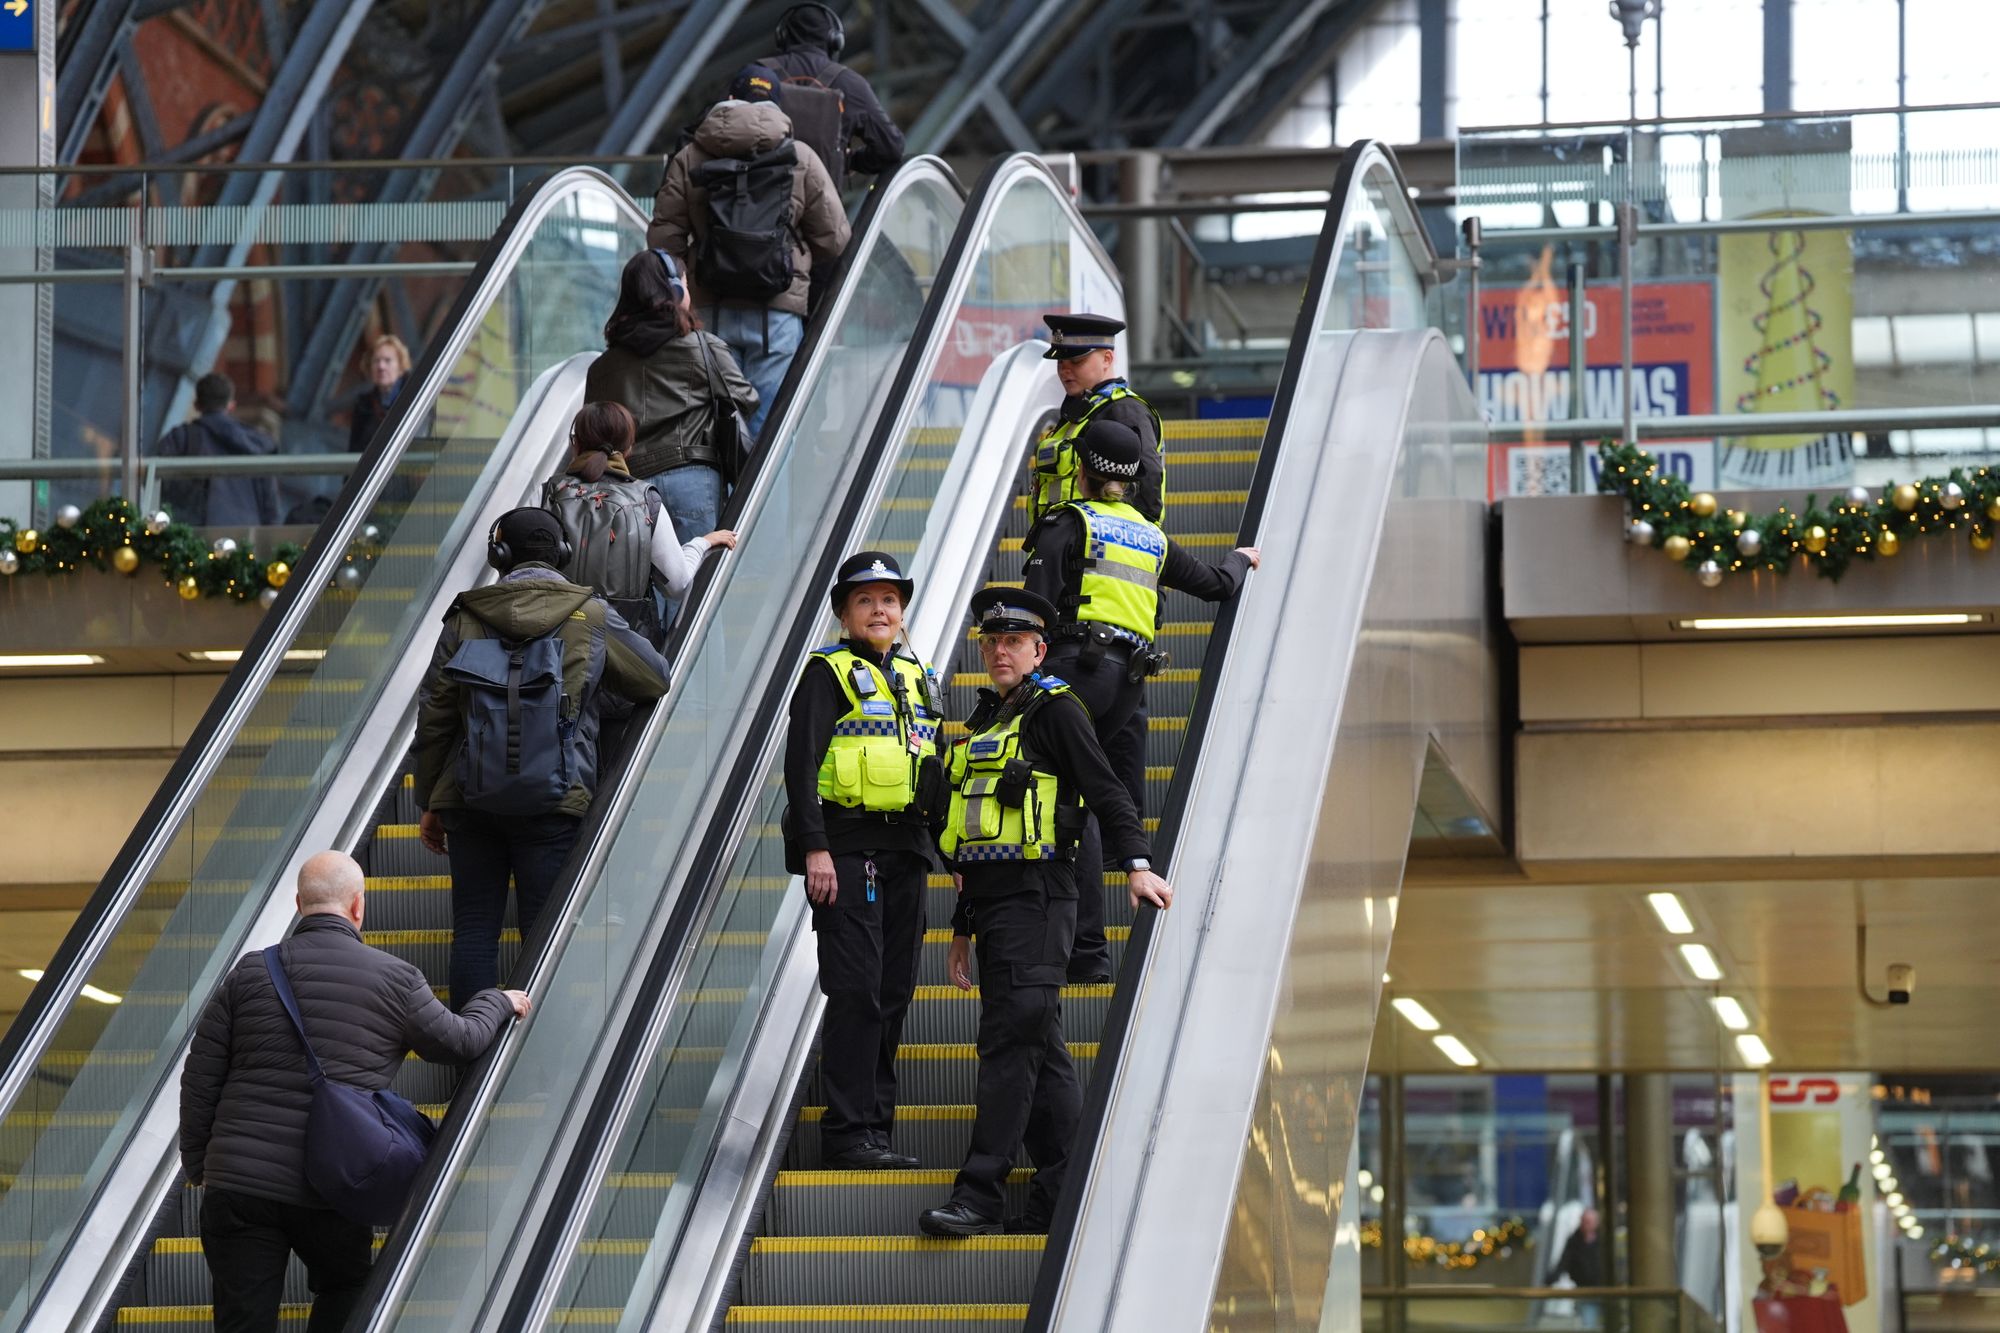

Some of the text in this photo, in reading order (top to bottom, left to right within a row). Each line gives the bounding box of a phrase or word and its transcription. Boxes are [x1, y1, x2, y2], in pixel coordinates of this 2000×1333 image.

[1480, 366, 1677, 421] HOW WAS
[1100, 522, 1160, 553] POLICE
